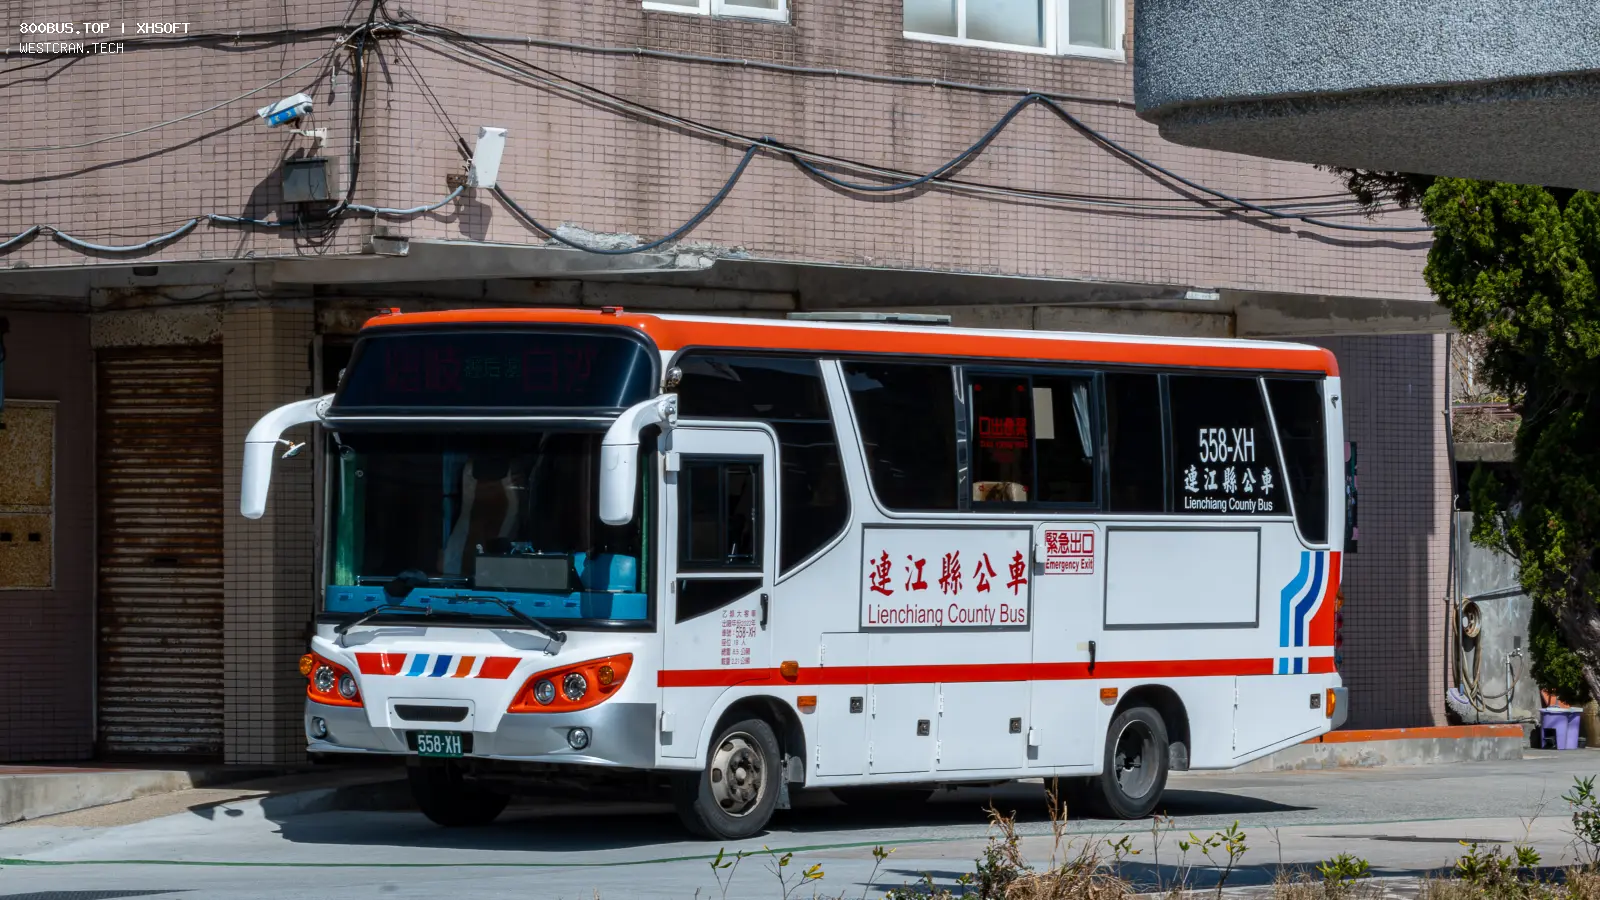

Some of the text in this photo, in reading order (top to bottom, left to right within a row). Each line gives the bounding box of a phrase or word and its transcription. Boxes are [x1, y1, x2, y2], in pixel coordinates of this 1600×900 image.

[1199, 428, 1255, 462] 558-XH
[1183, 464, 1274, 495] 連江縣公車
[1184, 496, 1273, 513] Lienchiang County Bus
[1045, 532, 1094, 554] 緊急出口
[869, 549, 1028, 596] 連江縣公車
[1045, 557, 1094, 572] Emergency Exit
[868, 603, 1026, 627] Lienchiang County Bus
[417, 734, 462, 754] 558-XH
